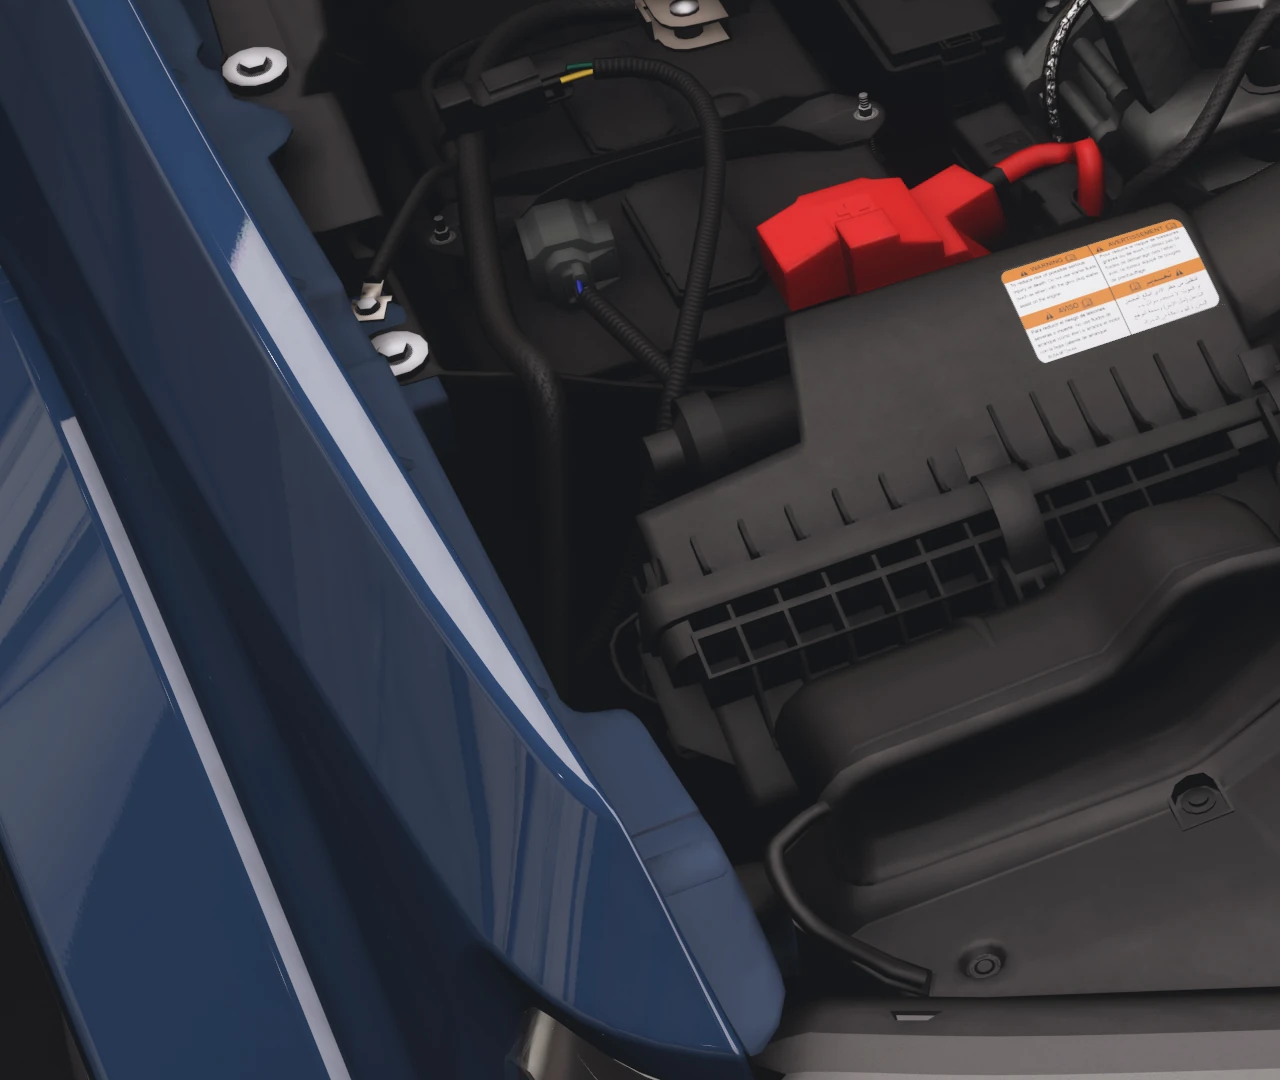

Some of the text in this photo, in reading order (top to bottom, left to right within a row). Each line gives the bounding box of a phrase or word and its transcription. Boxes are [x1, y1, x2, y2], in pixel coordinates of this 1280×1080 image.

[1108, 226, 1162, 246] AVERTISSEMENT
[1030, 258, 1063, 271] WARNING
[1058, 302, 1078, 313] AVISO
